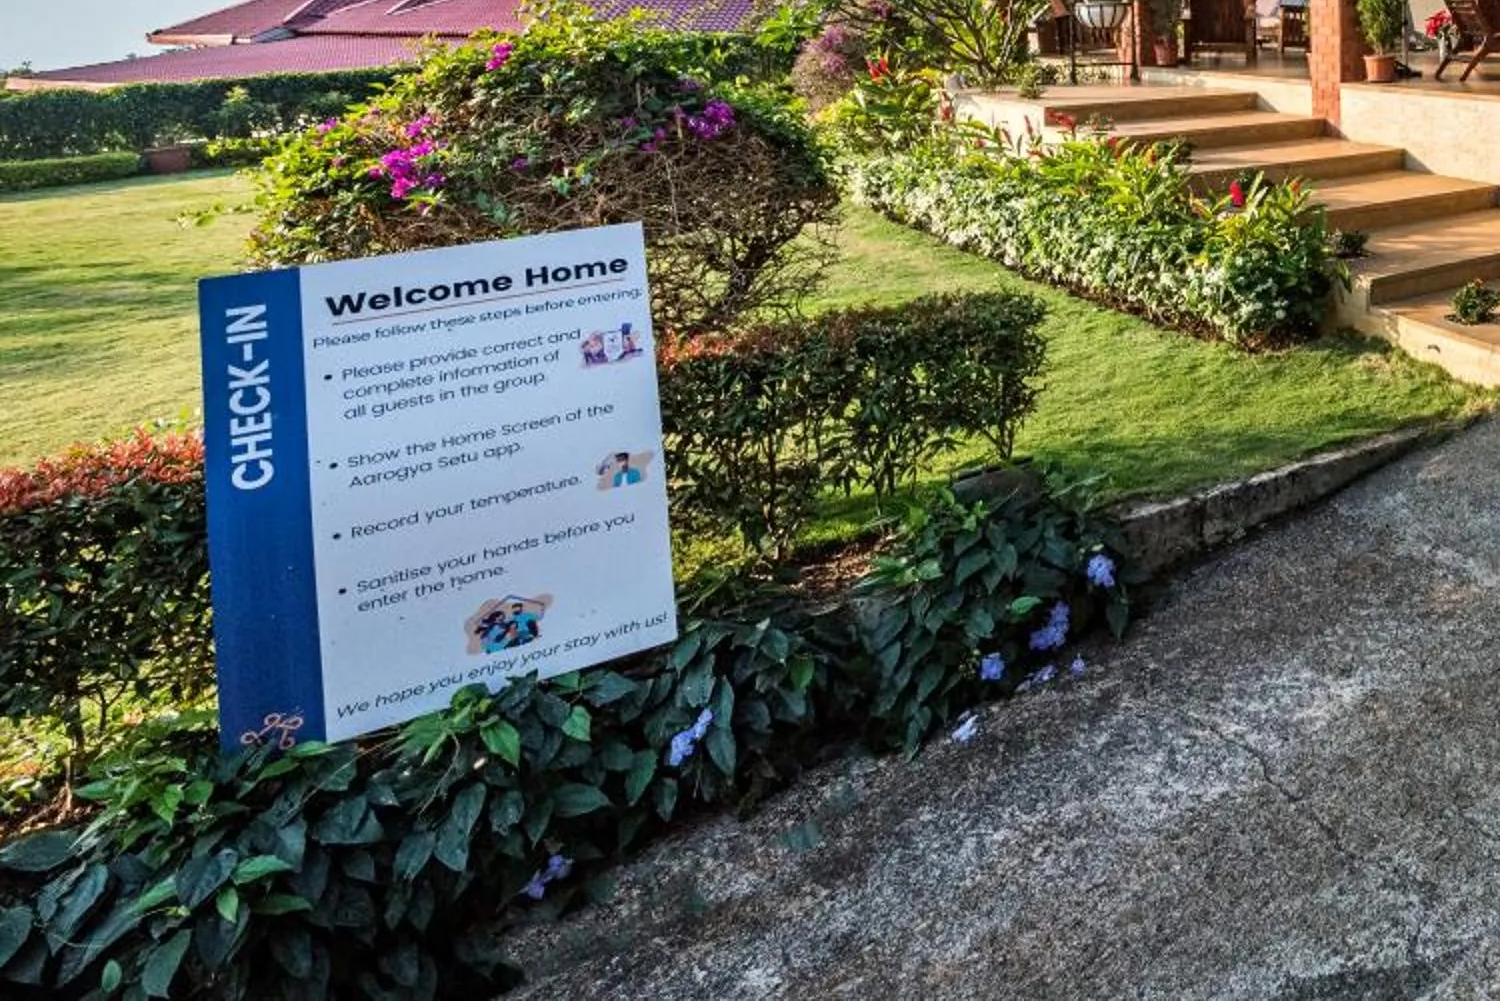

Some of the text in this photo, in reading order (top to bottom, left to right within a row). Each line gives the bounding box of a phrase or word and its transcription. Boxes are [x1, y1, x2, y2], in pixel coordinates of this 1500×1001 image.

[326, 258, 628, 316] Welcome Home
[313, 332, 370, 348] Please
[376, 323, 426, 338] follow
[431, 315, 476, 330] these
[479, 307, 521, 322] steps
[525, 298, 575, 314] before
[342, 329, 581, 380] Please provide correct and
[343, 350, 560, 399] complete information of
[225, 304, 274, 489] CHECK-IN
[343, 404, 366, 420] all
[371, 393, 434, 418] guests
[439, 386, 454, 400] in
[461, 382, 488, 397] the
[347, 404, 614, 468] Show the Home Screen of the
[349, 442, 524, 487] Aarogya Setu app.
[351, 475, 582, 538] Record your temperature.
[357, 513, 635, 593] Sanitise your hands before you
[357, 566, 508, 612] enter the home.
[337, 611, 667, 719] We hope you enjoy your stay with us!
